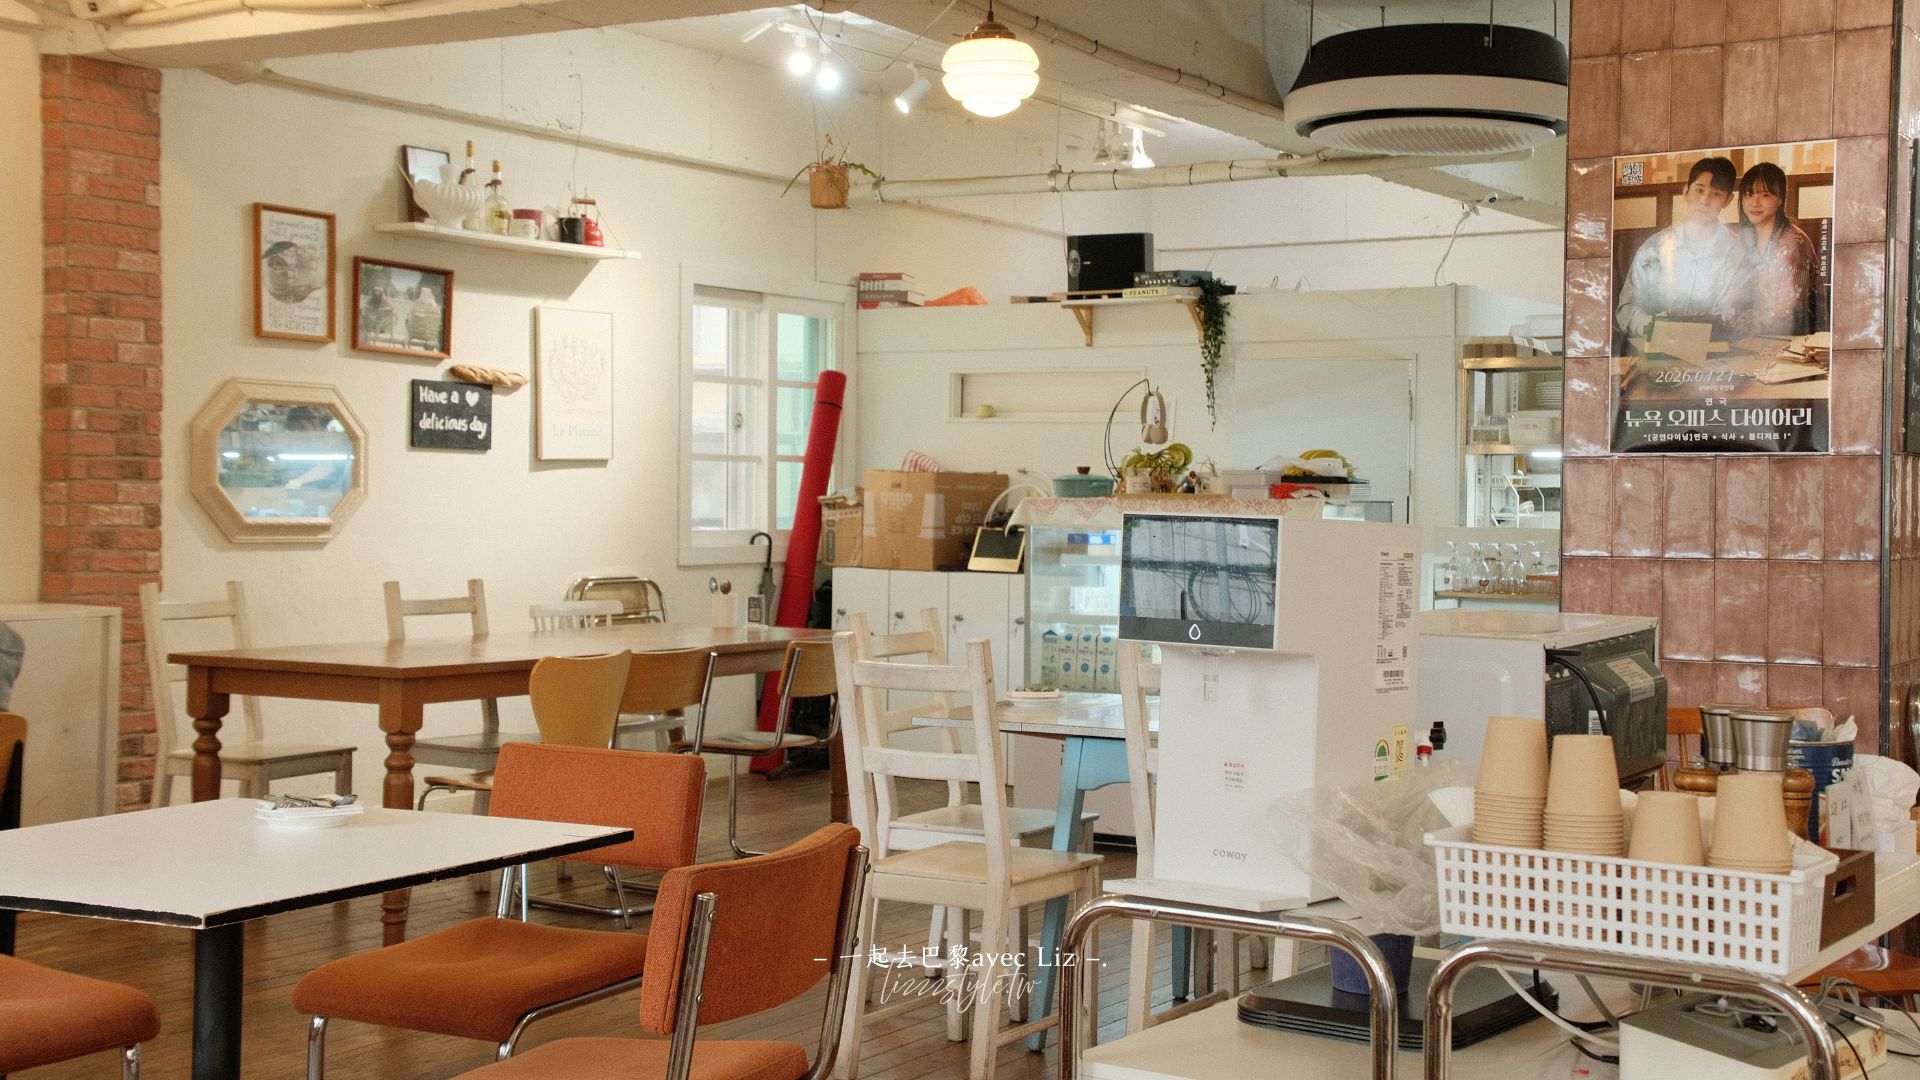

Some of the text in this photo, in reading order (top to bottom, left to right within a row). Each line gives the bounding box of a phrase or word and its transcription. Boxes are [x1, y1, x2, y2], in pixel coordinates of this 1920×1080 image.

[419, 386, 459, 404] Have a
[419, 412, 487, 440] delicious day
[1624, 407, 1813, 428] 뉴욕 오피스 다이어리
[1212, 848, 1248, 862] coway
